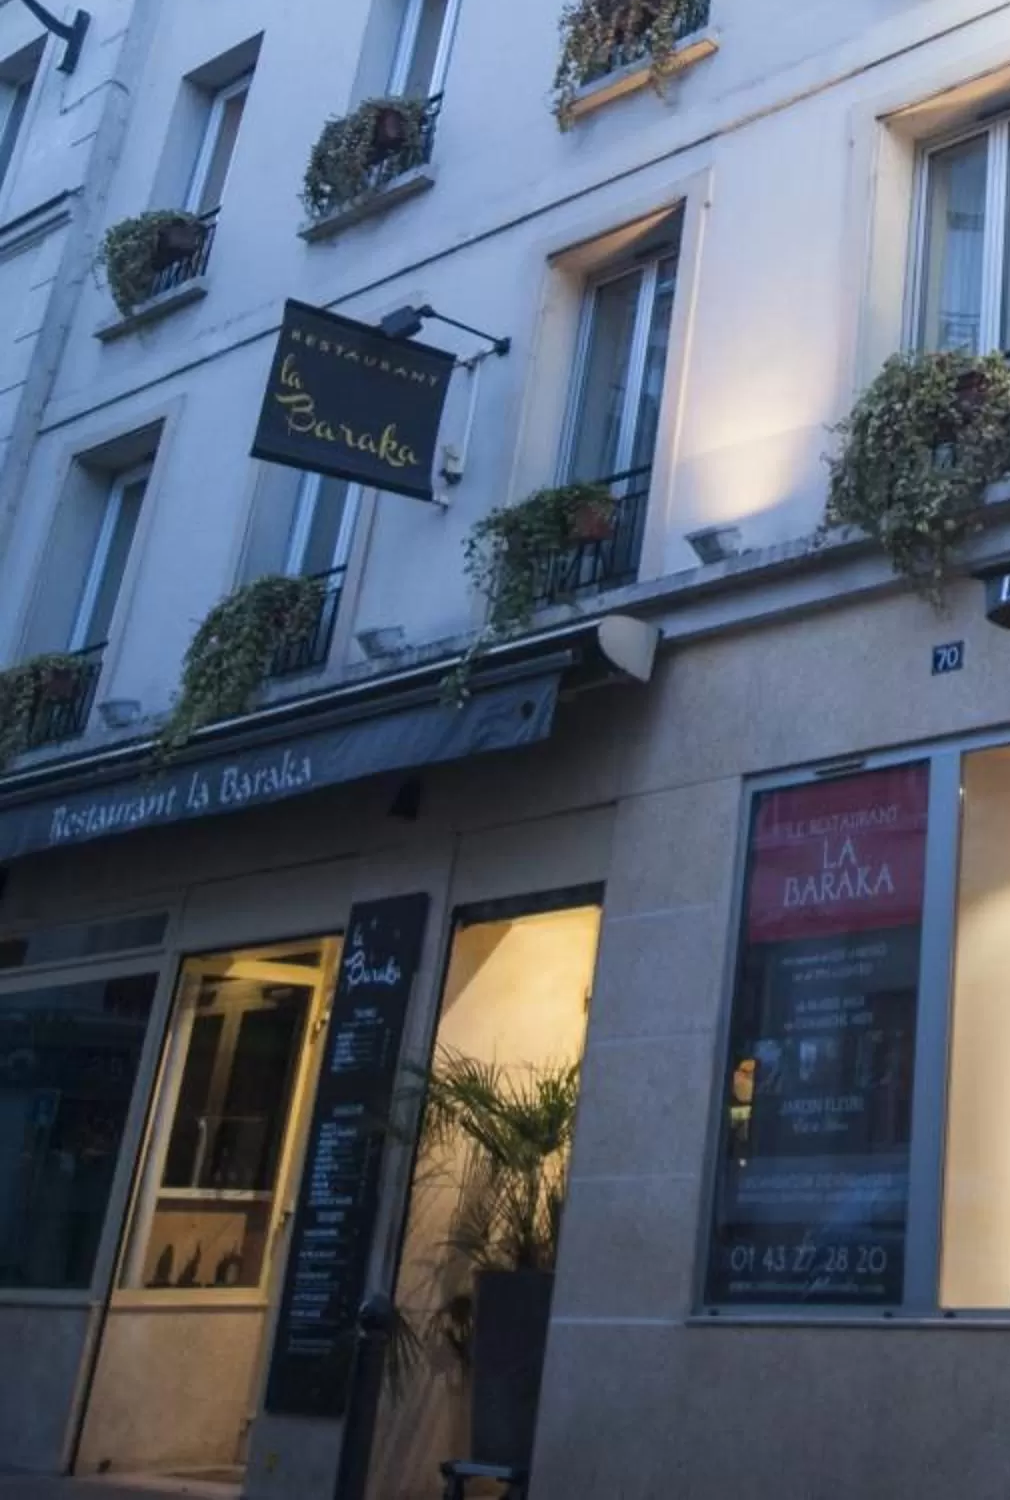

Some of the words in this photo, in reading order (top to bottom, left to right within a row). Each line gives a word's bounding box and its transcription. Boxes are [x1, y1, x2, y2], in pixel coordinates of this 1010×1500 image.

[280, 353, 304, 390] la
[290, 330, 440, 388] RESTAURANT
[275, 392, 420, 468] Baraka
[935, 646, 959, 671] 70
[50, 784, 178, 842] Restaurant
[219, 749, 312, 803] Baraka
[823, 835, 858, 870] LA
[783, 863, 896, 908] BARAKA
[731, 1244, 756, 1273] 01
[762, 1245, 786, 1273] 43
[791, 1245, 817, 1272] 27
[825, 1246, 849, 1273] 28
[856, 1245, 888, 1274] 20
